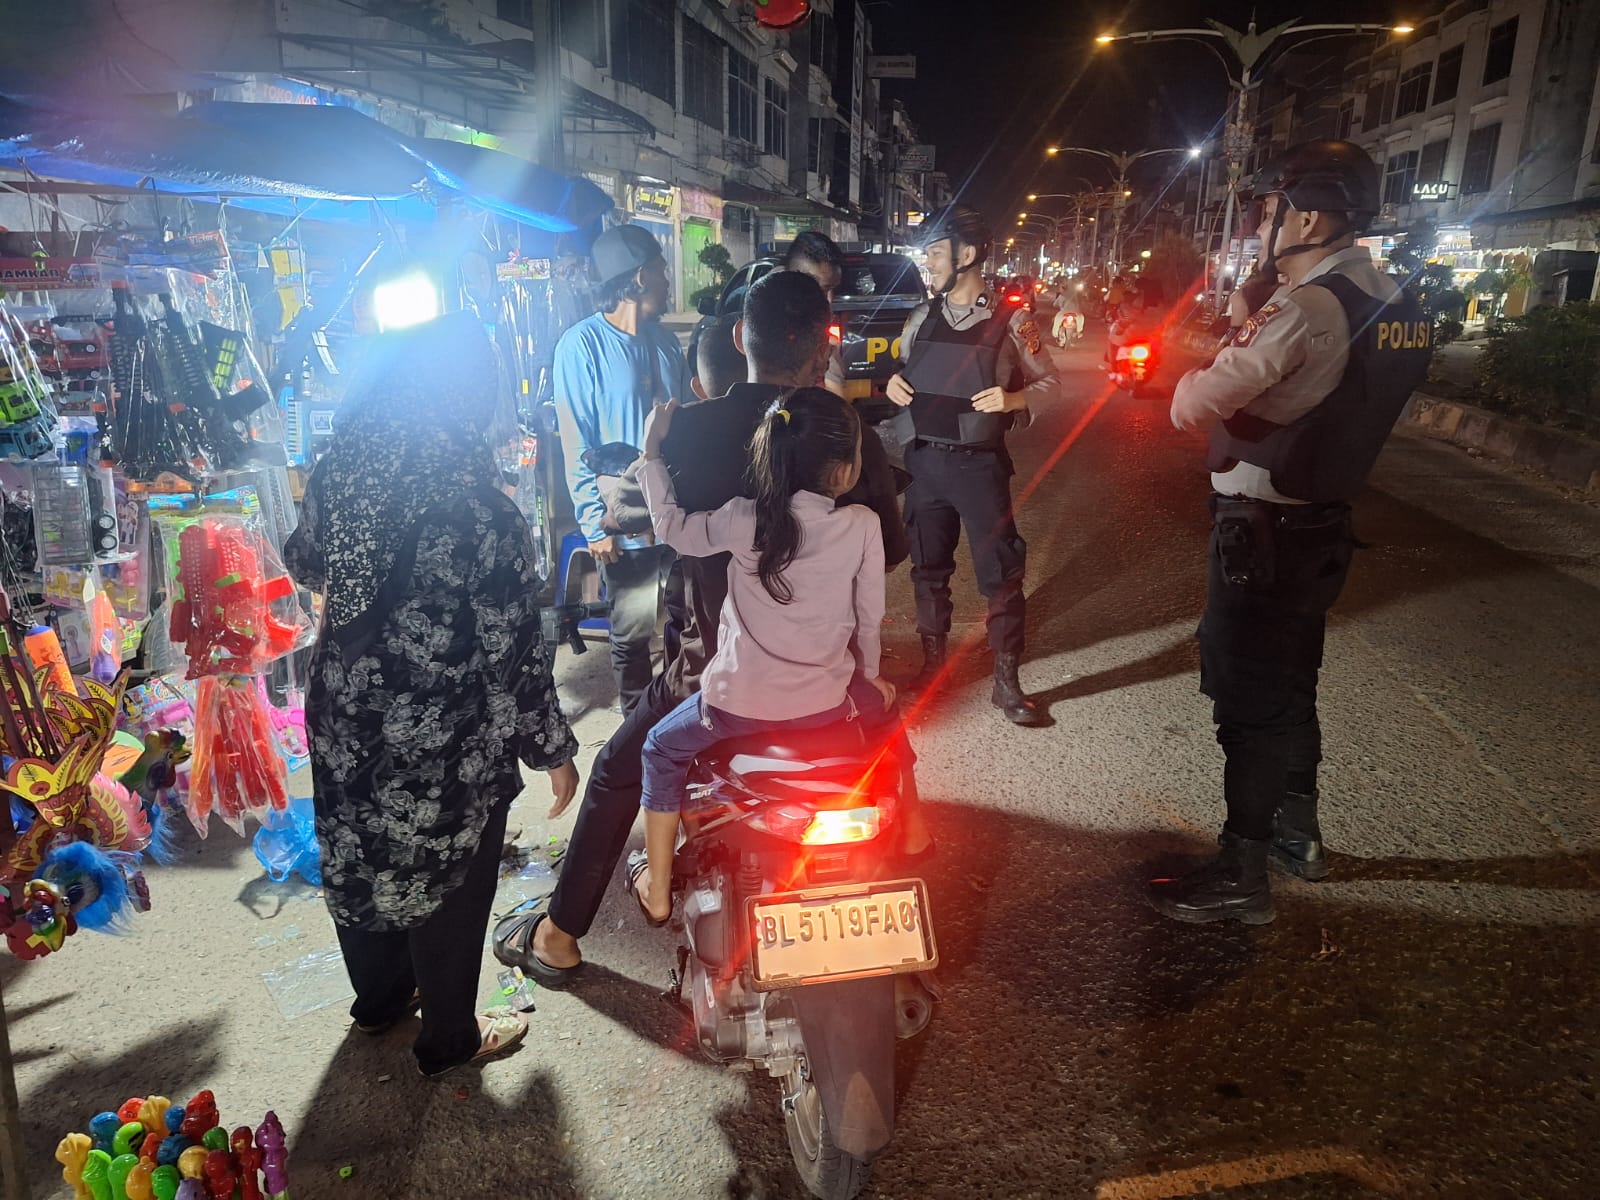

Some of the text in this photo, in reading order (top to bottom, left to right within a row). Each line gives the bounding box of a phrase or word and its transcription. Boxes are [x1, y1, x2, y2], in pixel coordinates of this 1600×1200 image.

[262, 84, 318, 105] TOKO MAS
[1377, 321, 1430, 350] POLISI
